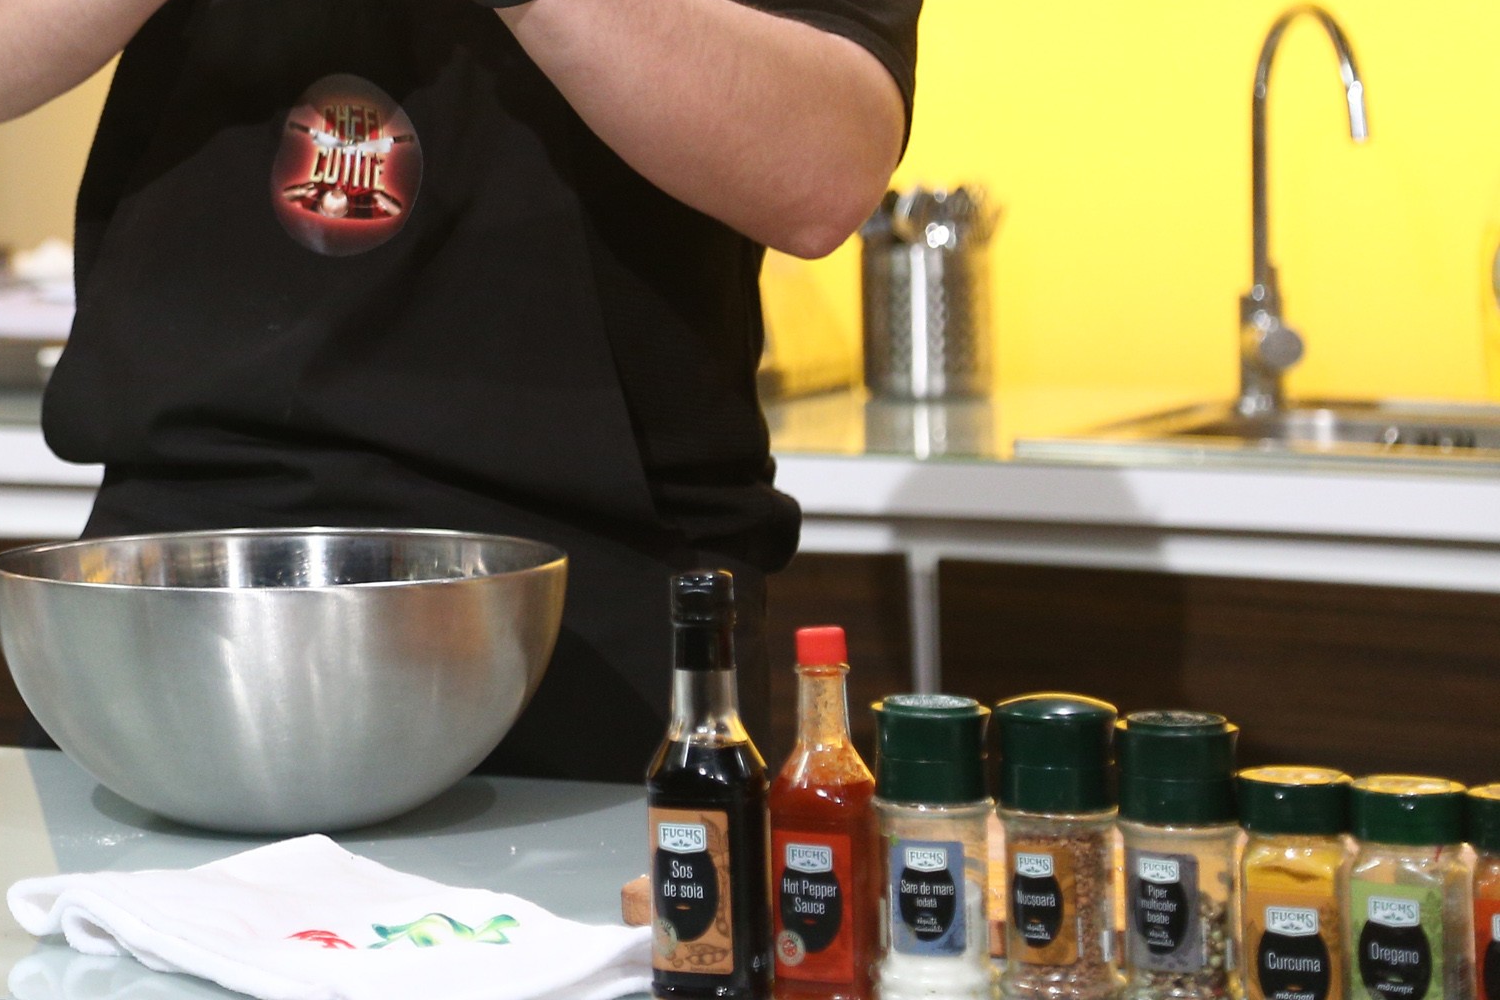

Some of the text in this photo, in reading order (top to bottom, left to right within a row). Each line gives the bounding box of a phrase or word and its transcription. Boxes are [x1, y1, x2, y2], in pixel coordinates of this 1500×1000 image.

[662, 827, 702, 845] FUCHS
[791, 849, 828, 865] FUCHS
[910, 851, 943, 865] FUCHS
[1019, 857, 1050, 871] FUCHS
[671, 860, 693, 879] Sos
[1143, 863, 1175, 878] FUCHS
[663, 879, 704, 899] de soia
[783, 878, 837, 899] Hot Pepper
[901, 879, 955, 896] Sare de mare
[1148, 885, 1168, 899] Piper
[794, 897, 826, 915] Sauce
[916, 897, 938, 909] iodată
[1017, 889, 1056, 908] Nucșoară
[1141, 899, 1177, 913] multicolor
[1147, 911, 1170, 925] boabe
[1373, 900, 1415, 919] FUCHS
[1271, 911, 1314, 928] FUCHS
[1371, 942, 1419, 965] Oregano
[1268, 952, 1321, 973] Curcuma
